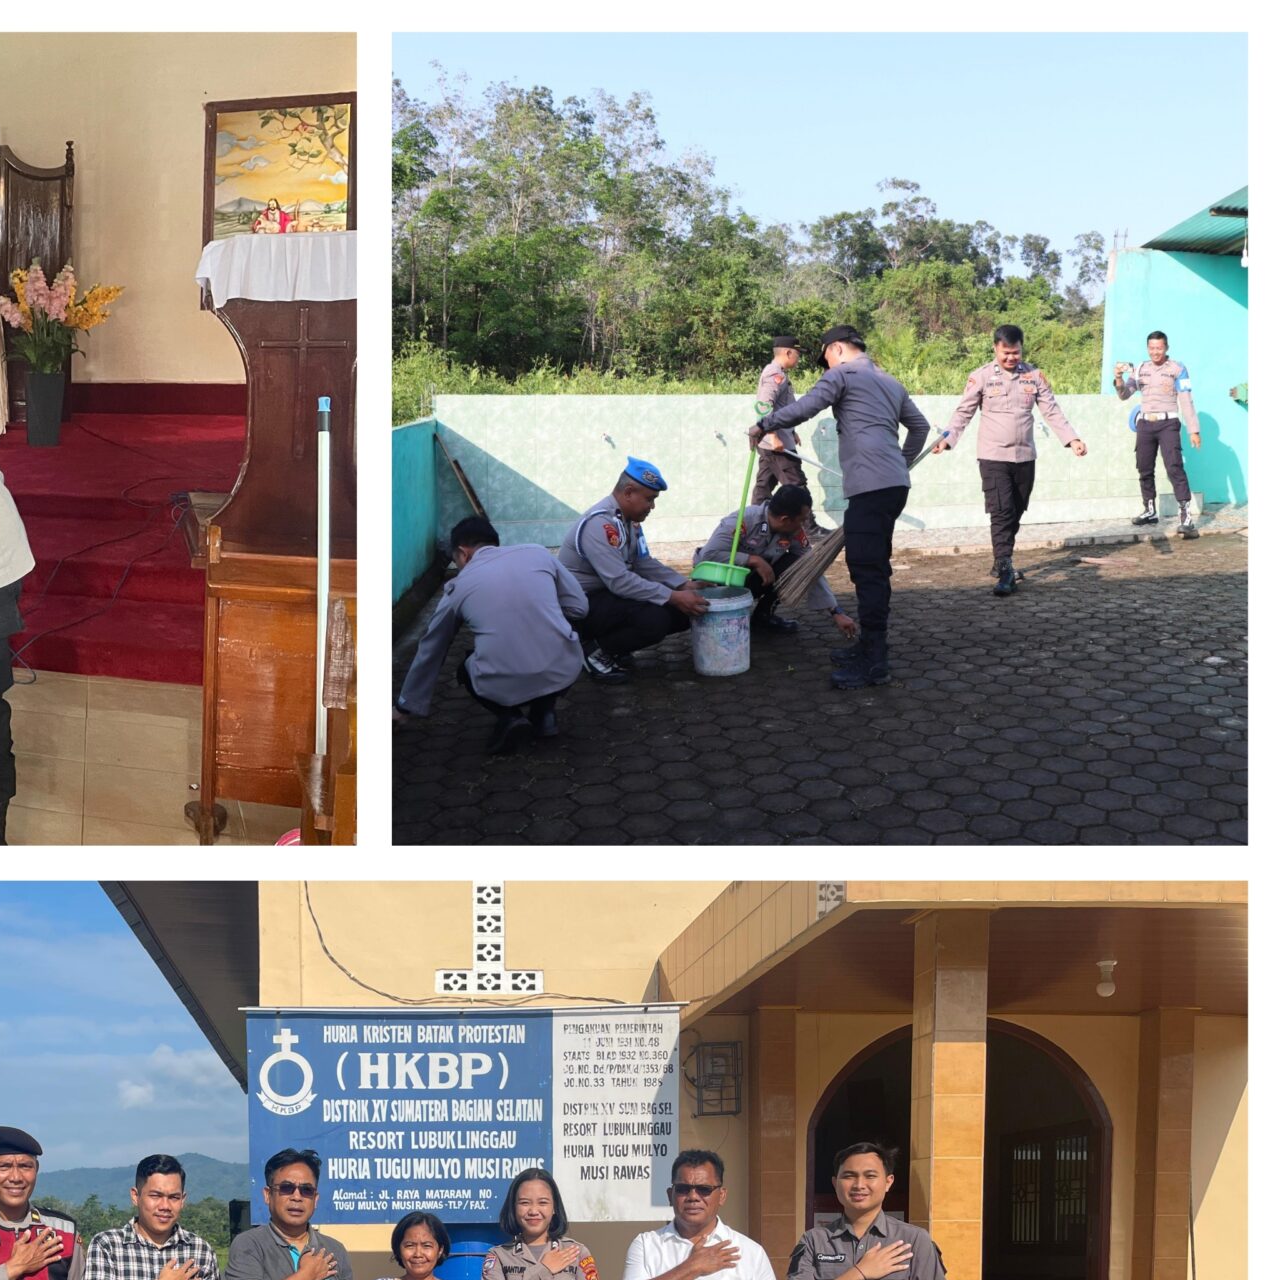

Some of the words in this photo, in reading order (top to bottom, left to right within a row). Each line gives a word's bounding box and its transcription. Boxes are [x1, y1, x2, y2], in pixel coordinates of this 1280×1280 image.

[323, 1025, 358, 1043] HURIA
[363, 1025, 412, 1044] KRISTEN
[417, 1025, 454, 1044] BATAK
[458, 1024, 525, 1044] PROTESTAN
[615, 1023, 663, 1034] PEMERINTAH
[563, 1051, 590, 1061] STAATS
[322, 1099, 369, 1122] DISTRIK
[371, 1099, 388, 1122] XV
[390, 1099, 448, 1122] SUMATERA
[452, 1098, 493, 1121] BAGIAN
[496, 1098, 543, 1121] SELATAN
[563, 1122, 598, 1136] RESORT
[603, 1122, 672, 1136] LUBUKLINGGAU
[349, 1130, 405, 1150] RESORT
[564, 1144, 595, 1158] HURIA
[602, 1144, 629, 1157] TUGU
[632, 1143, 668, 1157] MULYO
[327, 1158, 371, 1179] HURIA
[374, 1158, 412, 1179] TUGU
[413, 1158, 461, 1179] MULYO
[464, 1157, 500, 1179] MUSI
[580, 1165, 609, 1180] MUSI
[613, 1165, 650, 1180] RAWAS
[396, 1189, 420, 1200] RAYA
[425, 1189, 471, 1199] MATARAM
[334, 1201, 355, 1211] TUGU
[357, 1201, 388, 1211] MULYO
